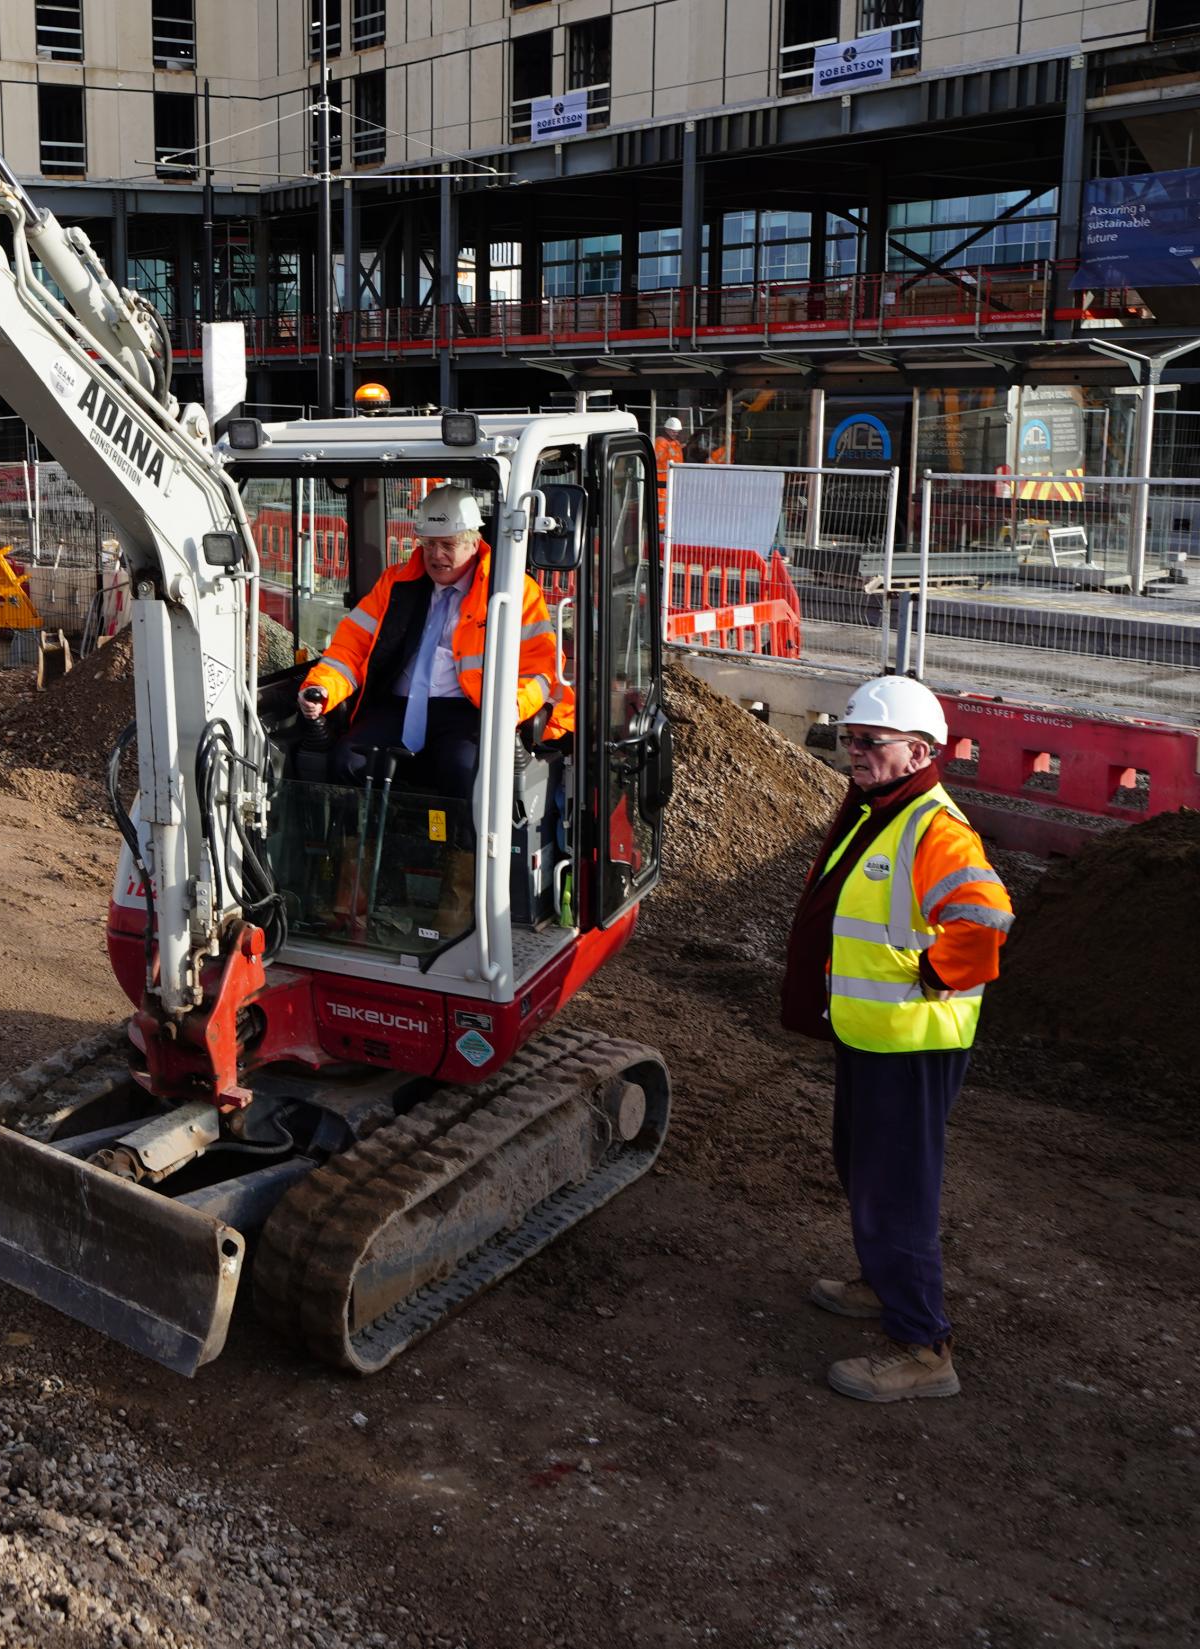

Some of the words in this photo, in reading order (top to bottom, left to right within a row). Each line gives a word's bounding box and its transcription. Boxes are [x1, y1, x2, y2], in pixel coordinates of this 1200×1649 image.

[819, 58, 884, 78] ROBERTSON
[537, 113, 583, 128] ROBERTSON
[1089, 205, 1137, 216] Assuring
[1139, 204, 1146, 213] a
[1087, 217, 1151, 231] sustainable
[1087, 233, 1118, 245] future
[77, 378, 165, 488] ADANA
[836, 423, 884, 450] ACE
[89, 427, 142, 487] CONSTRUCTION
[957, 702, 983, 714] ROAD
[327, 1002, 428, 1034] TAKEUCHI
